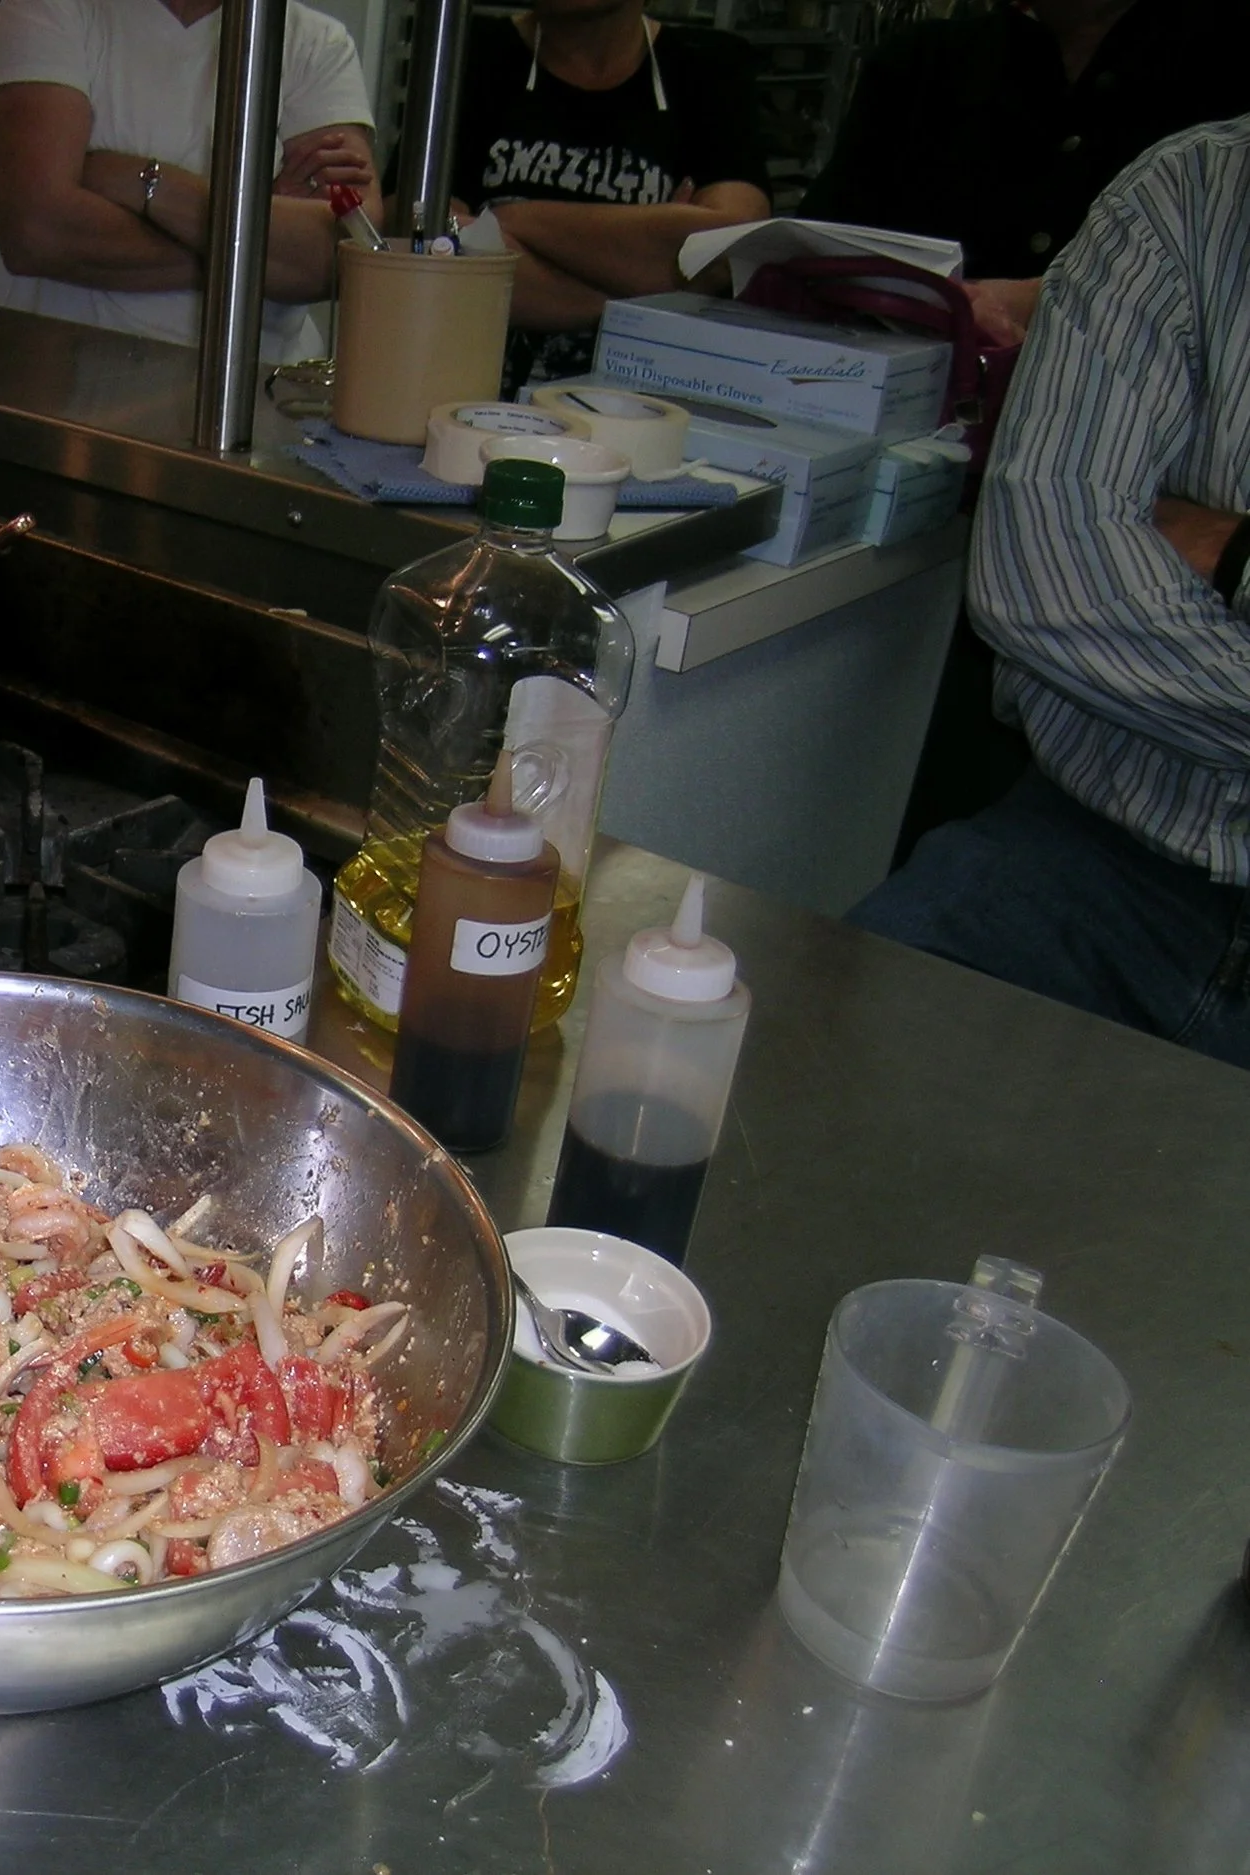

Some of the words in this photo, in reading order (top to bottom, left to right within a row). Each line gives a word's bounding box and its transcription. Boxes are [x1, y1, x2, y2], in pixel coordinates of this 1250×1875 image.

[605, 359, 638, 379] Vinyl
[641, 367, 713, 394] Disposable
[715, 382, 764, 405] Gloves
[770, 358, 866, 378] Essentials
